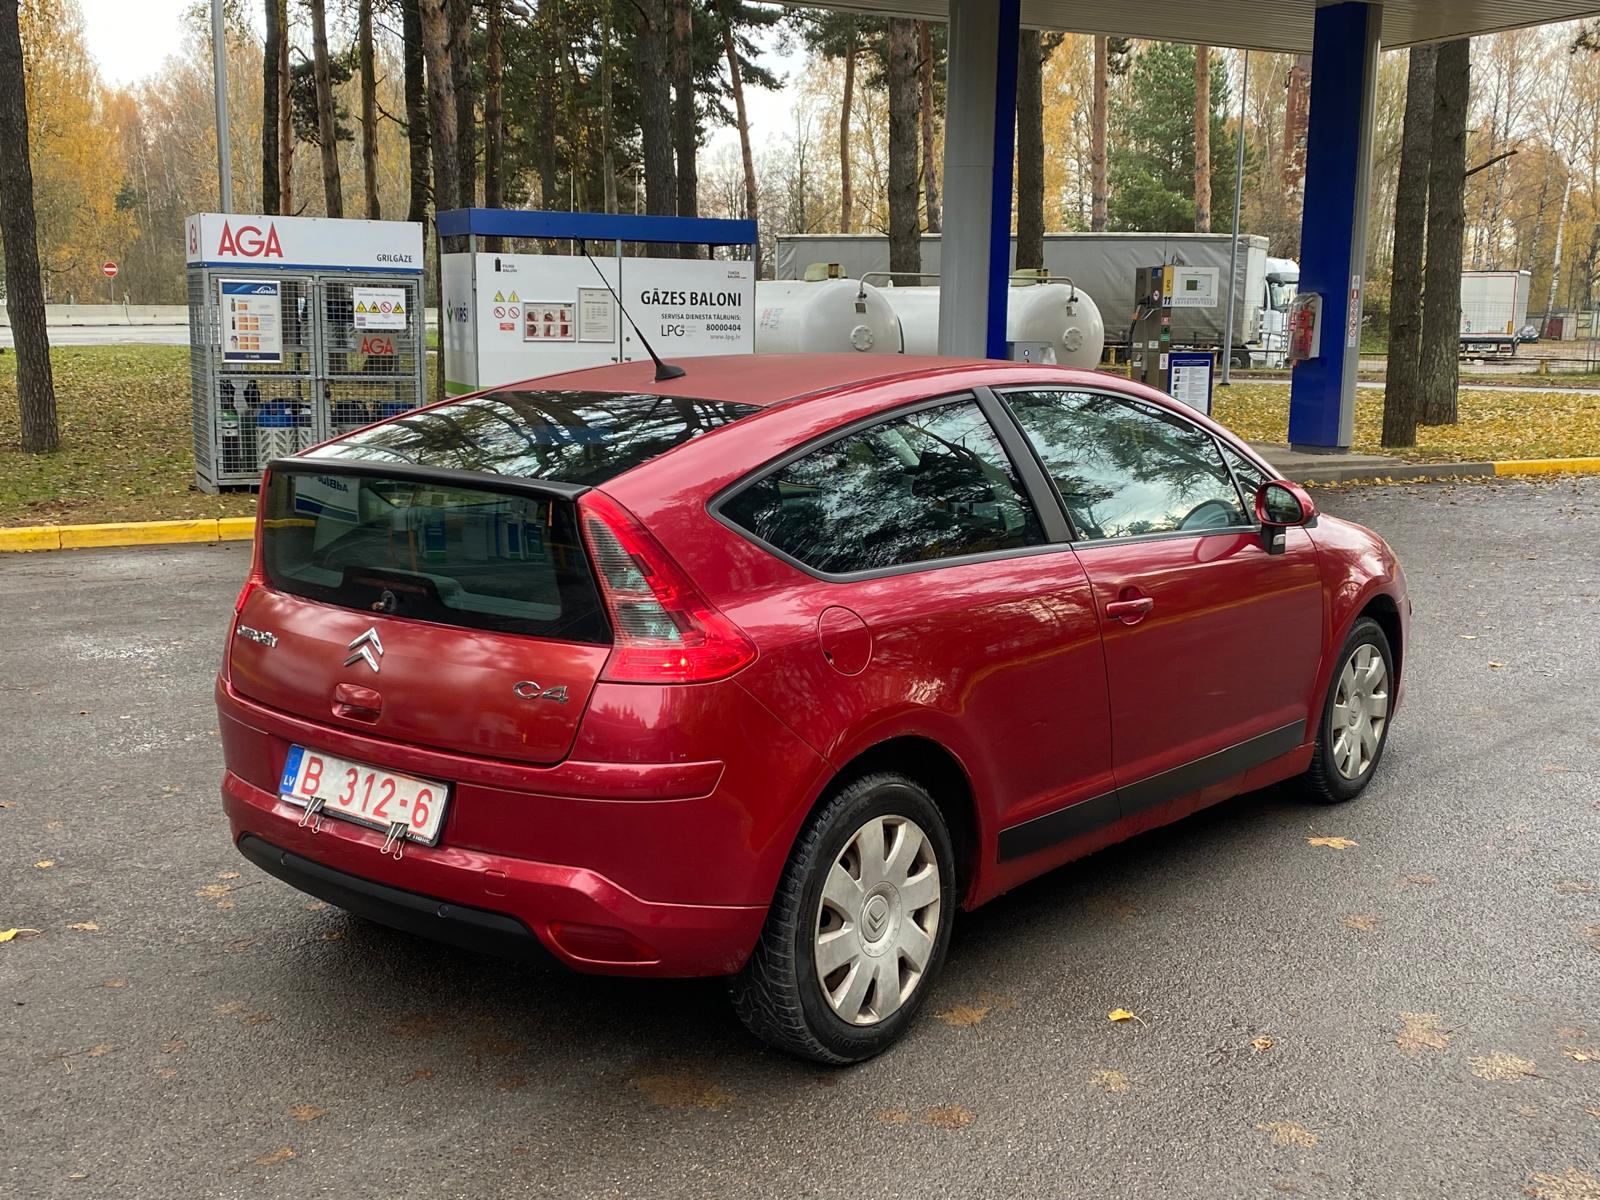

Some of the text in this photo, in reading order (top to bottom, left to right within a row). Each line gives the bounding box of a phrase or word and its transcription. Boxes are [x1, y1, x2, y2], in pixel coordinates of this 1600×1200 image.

[217, 219, 284, 257] AGA
[641, 288, 742, 307] GĀZES BALONI
[1163, 296, 1172, 305] 11
[661, 325, 685, 337] LPG
[706, 324, 742, 332] 80000404
[361, 336, 394, 355] AGA
[512, 680, 569, 704] C4
[283, 776, 295, 787] LV
[301, 756, 434, 829] B 312-6
